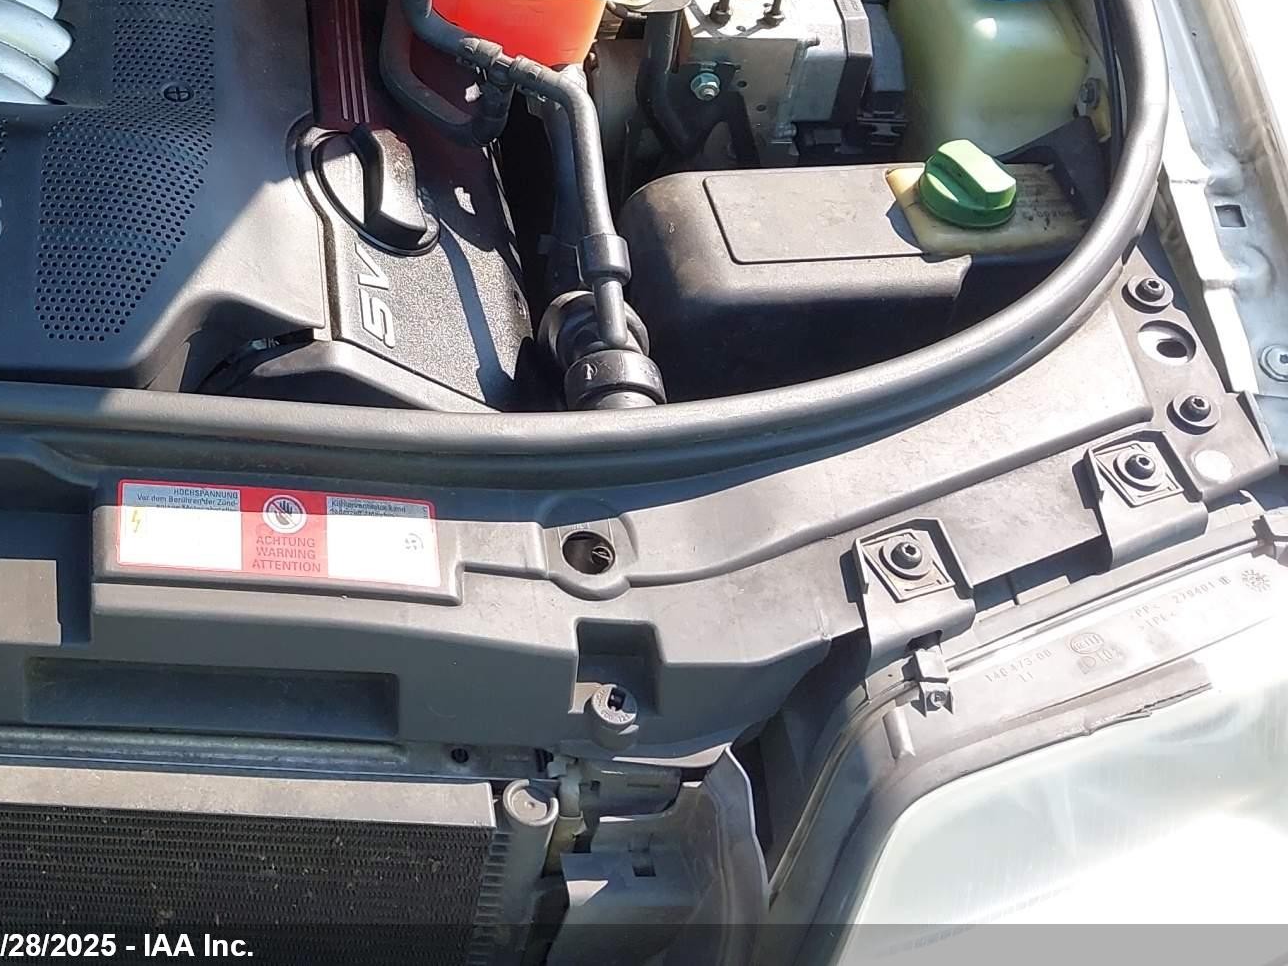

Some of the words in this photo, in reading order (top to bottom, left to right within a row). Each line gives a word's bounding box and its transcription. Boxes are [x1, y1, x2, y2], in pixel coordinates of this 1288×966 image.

[151, 494, 167, 503] dem
[168, 494, 202, 505] Berühren
[173, 488, 238, 500] HOCHSPANNUNG
[256, 536, 315, 548] ACHTUNG
[256, 546, 316, 560] WARNING
[252, 559, 321, 573] ATTENTION
